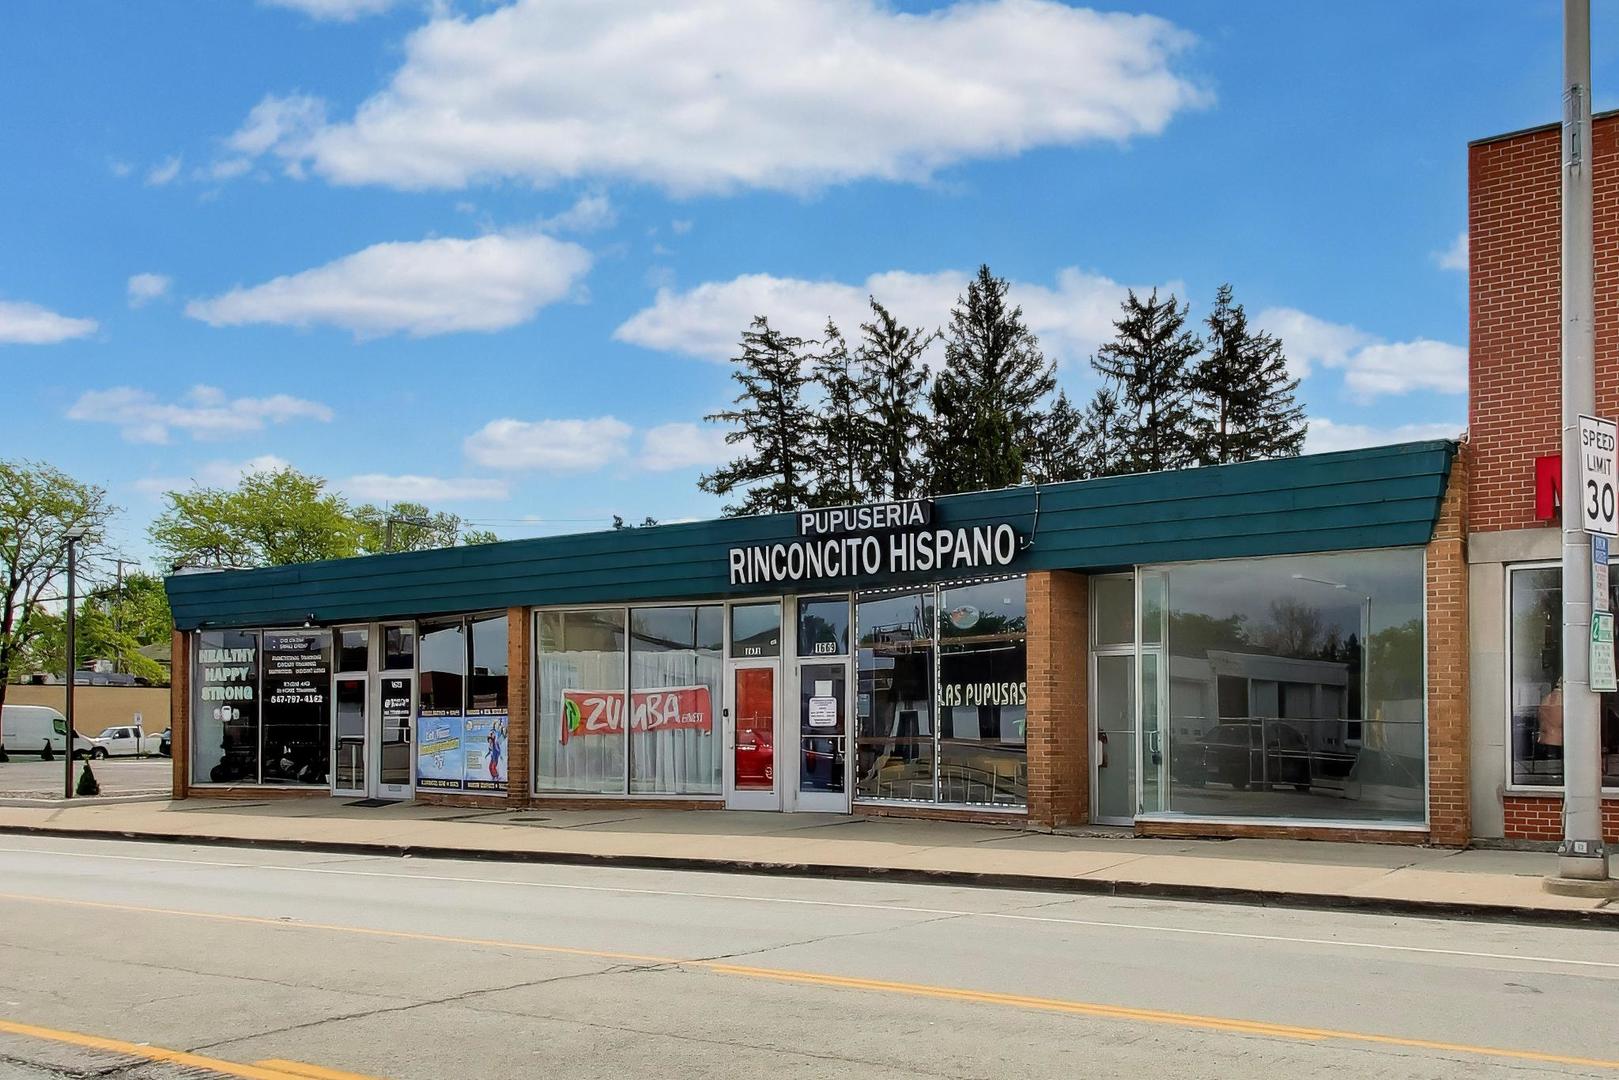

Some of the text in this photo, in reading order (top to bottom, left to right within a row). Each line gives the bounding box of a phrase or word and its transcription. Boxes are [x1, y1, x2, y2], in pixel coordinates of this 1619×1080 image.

[1583, 429, 1615, 452] SPEED
[1587, 454, 1611, 475] LIMIT
[1587, 480, 1615, 522] 30
[801, 502, 925, 535] PUPUSERIA
[729, 524, 1015, 585] RINCONCITO HISPANO
[198, 648, 256, 663] HEALTHY
[205, 667, 250, 681] HAPPY
[201, 685, 253, 700] STRONG
[966, 682, 1026, 706] PUPUSAS
[582, 694, 681, 730] ZUMBA
